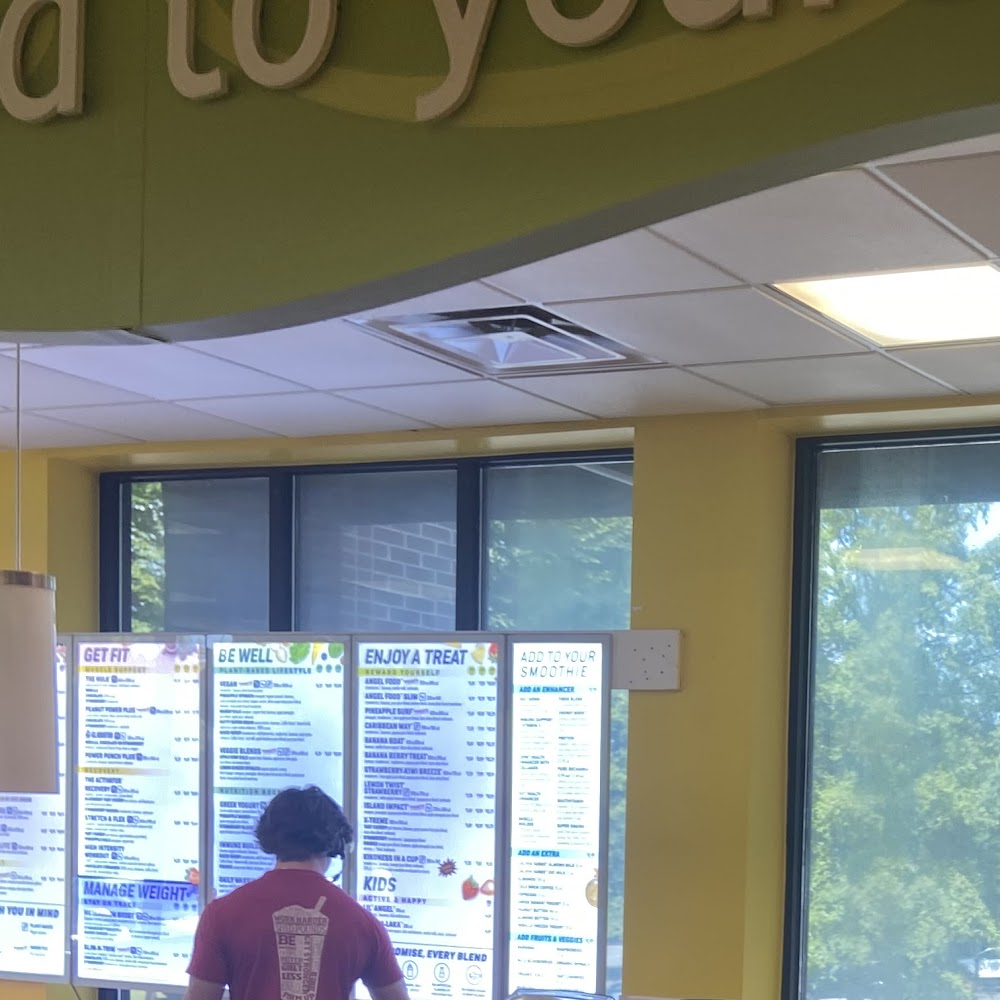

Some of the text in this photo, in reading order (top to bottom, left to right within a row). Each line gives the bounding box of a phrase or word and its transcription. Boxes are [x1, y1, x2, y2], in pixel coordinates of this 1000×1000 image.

[84, 647, 130, 663] GET FIT
[218, 648, 273, 663] BE WELL
[365, 649, 468, 665] ENJOY A TREAT
[521, 650, 596, 663] ADD TO YOUR
[520, 666, 588, 678] SMOOTHIE
[84, 880, 188, 901] MANAGE WEIGHT
[363, 876, 397, 892] KIDS
[7, 905, 24, 916] YOU
[26, 907, 35, 917] IN
[278, 935, 296, 946] BE
[427, 950, 488, 962] EVERY BLEND
